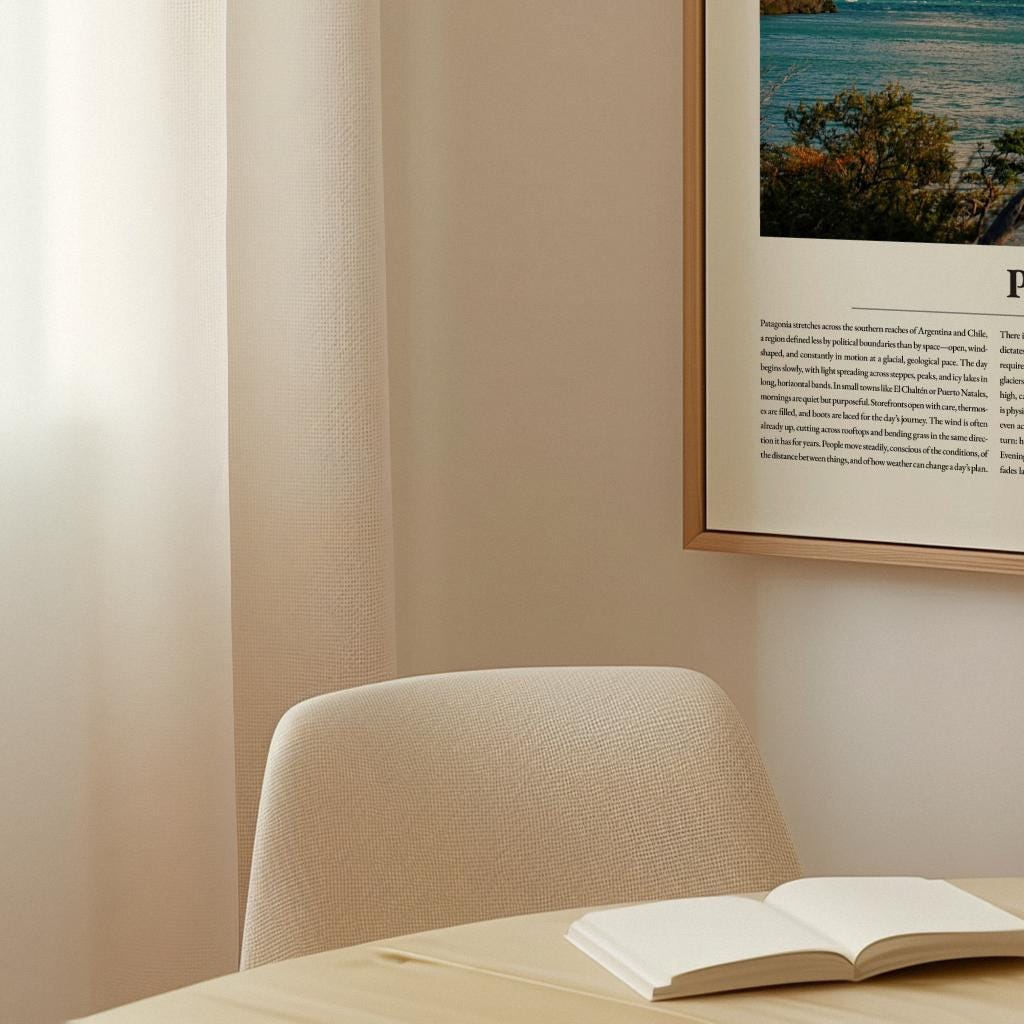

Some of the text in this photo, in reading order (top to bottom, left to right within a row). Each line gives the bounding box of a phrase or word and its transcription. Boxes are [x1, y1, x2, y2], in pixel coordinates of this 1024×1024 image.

[760, 319, 792, 331] Patagonia
[793, 322, 821, 330] stretches
[842, 323, 853, 332] the
[854, 324, 884, 333] southern
[884, 326, 909, 334] reaches
[917, 327, 952, 338] Argentina
[953, 329, 966, 337] and
[967, 329, 988, 338] Chile,
[760, 348, 785, 359] shaped,
[786, 350, 799, 358] and
[800, 352, 834, 362] constantly
[844, 354, 868, 362] motion
[882, 355, 906, 366] glacial,
[906, 356, 940, 368] geological
[941, 360, 958, 369] pace.
[960, 358, 975, 367] The
[975, 359, 988, 371] day
[760, 394, 792, 404] mornings
[801, 396, 820, 406] quiet
[818, 395, 832, 404] but
[832, 398, 870, 408] purposeful.
[870, 399, 908, 409] Storefronts
[906, 403, 925, 412] open
[925, 402, 941, 411] with
[941, 405, 958, 413] care,
[956, 403, 988, 413] thermos-
[999, 391, 1018, 402] high,
[760, 422, 784, 433] already
[784, 425, 795, 434] up,
[796, 425, 821, 435] cutting
[841, 427, 870, 438] rooftops
[870, 428, 883, 437] and
[884, 429, 912, 441] bending
[911, 433, 930, 441] grass
[938, 432, 950, 441] the
[968, 434, 988, 443] direc-
[1000, 465, 1018, 475] fades
